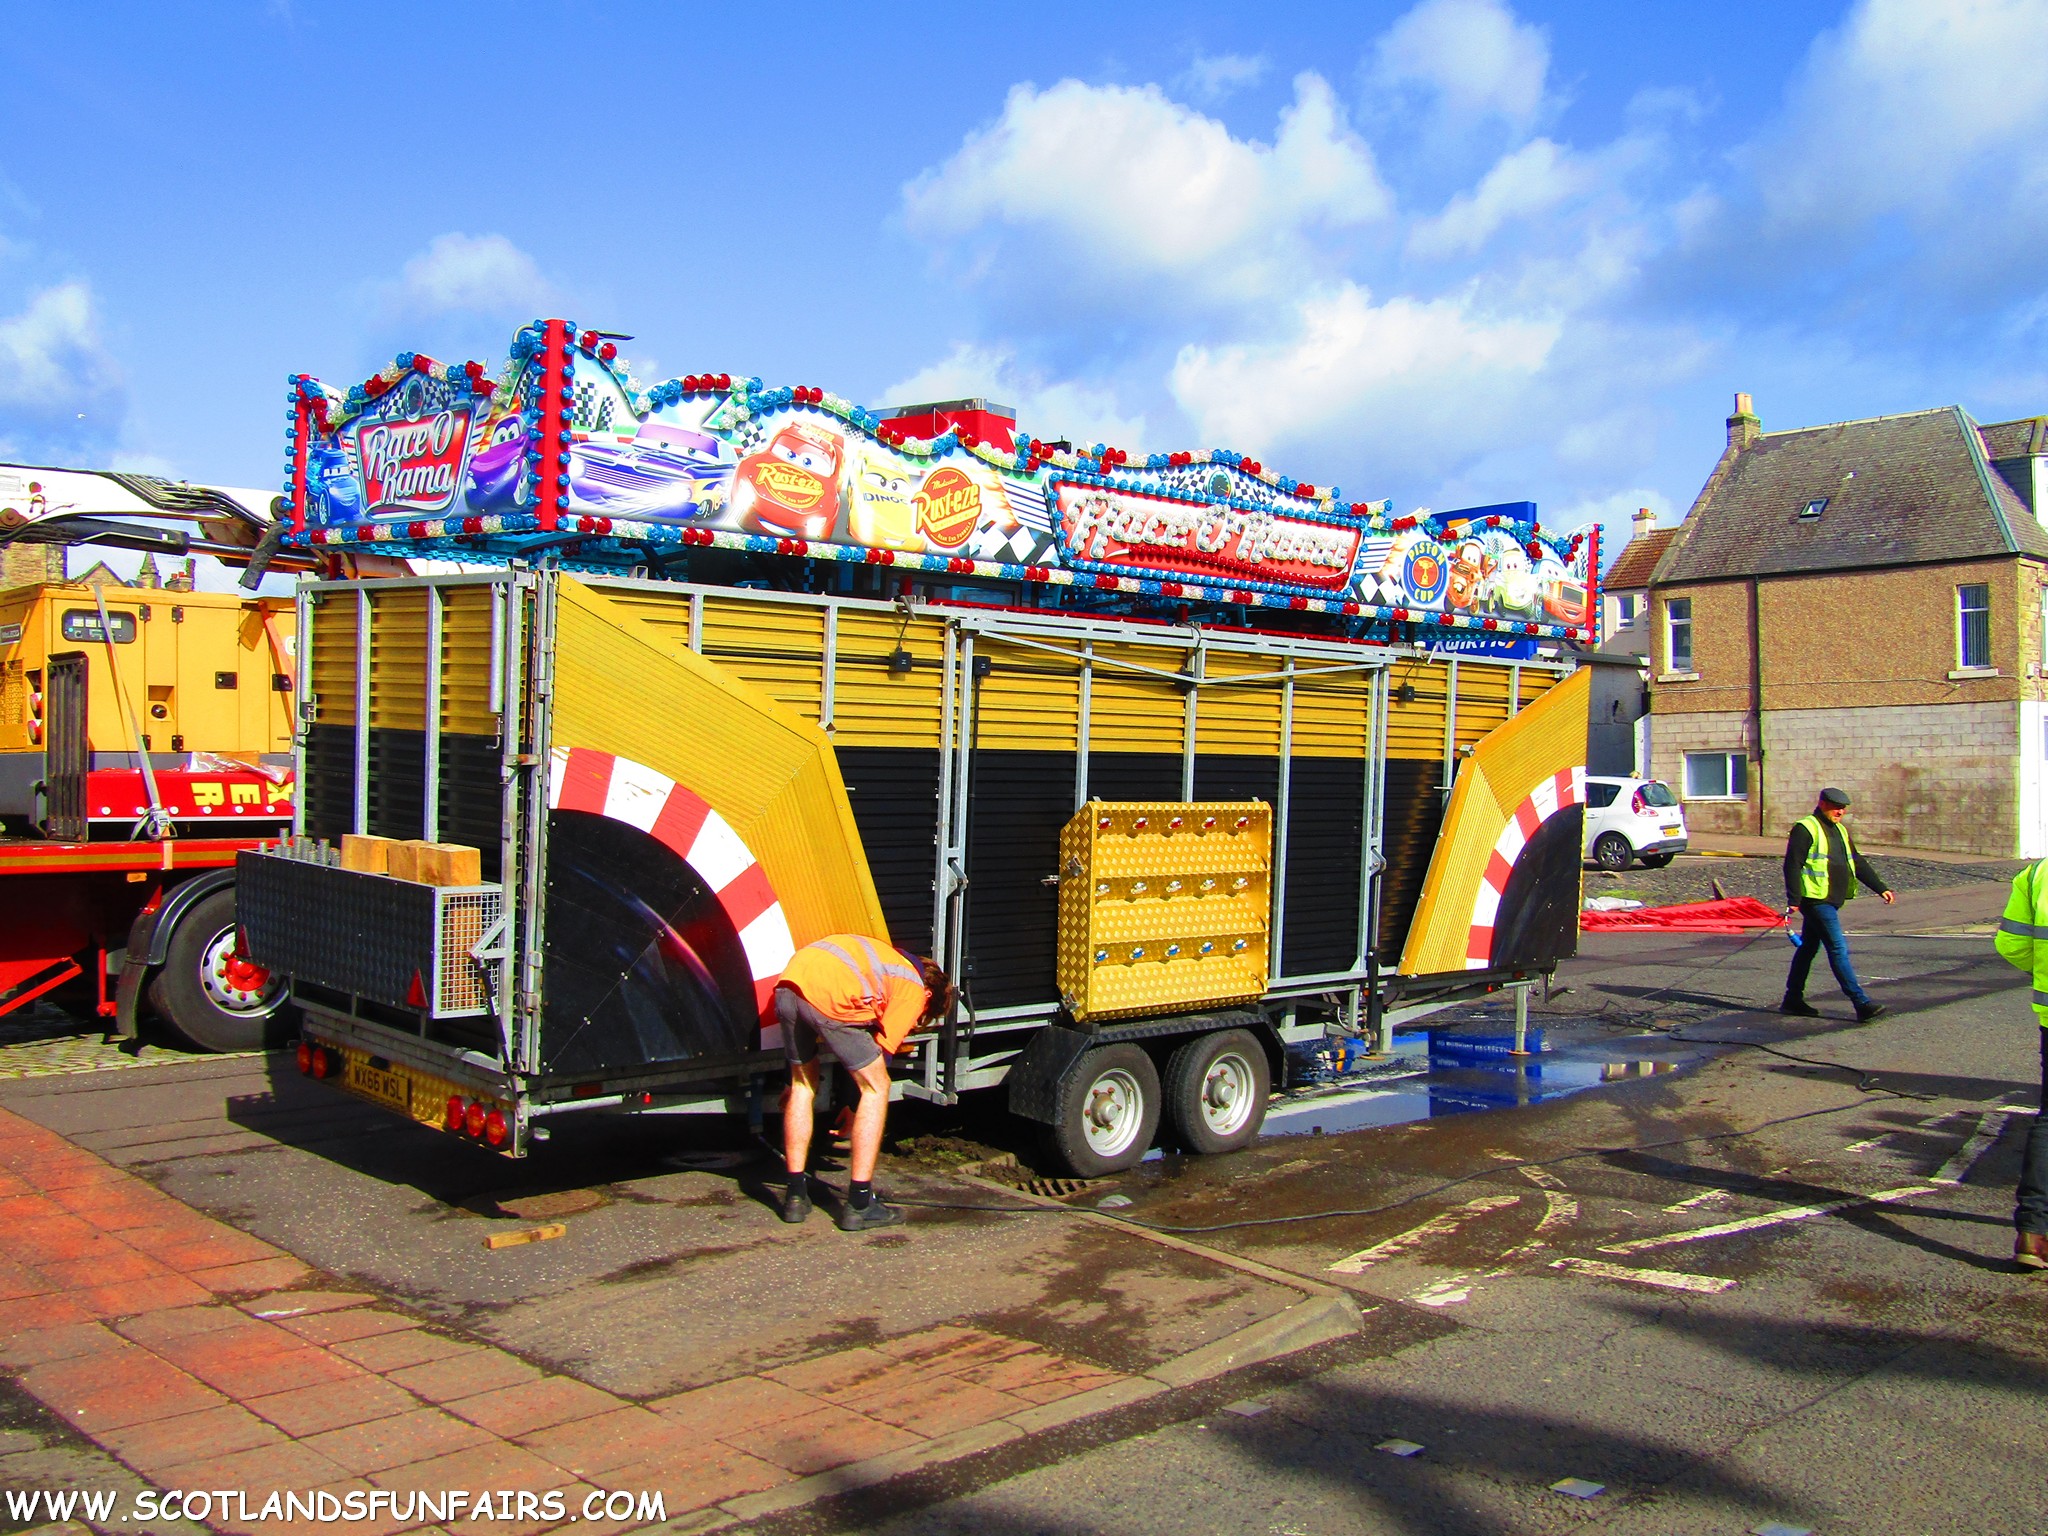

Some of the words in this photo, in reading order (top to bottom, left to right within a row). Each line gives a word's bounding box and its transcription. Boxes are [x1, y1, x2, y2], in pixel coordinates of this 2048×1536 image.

[366, 424, 429, 482] Race
[431, 409, 455, 457] O
[380, 459, 454, 505] Rama
[911, 484, 980, 533] Rust-eze
[1067, 490, 1197, 558] Race
[1230, 511, 1352, 568] Rama
[1408, 540, 1446, 566] PISTON
[1413, 589, 1435, 602] CUP
[354, 1065, 380, 1092] WX66
[383, 1074, 403, 1102] WSL
